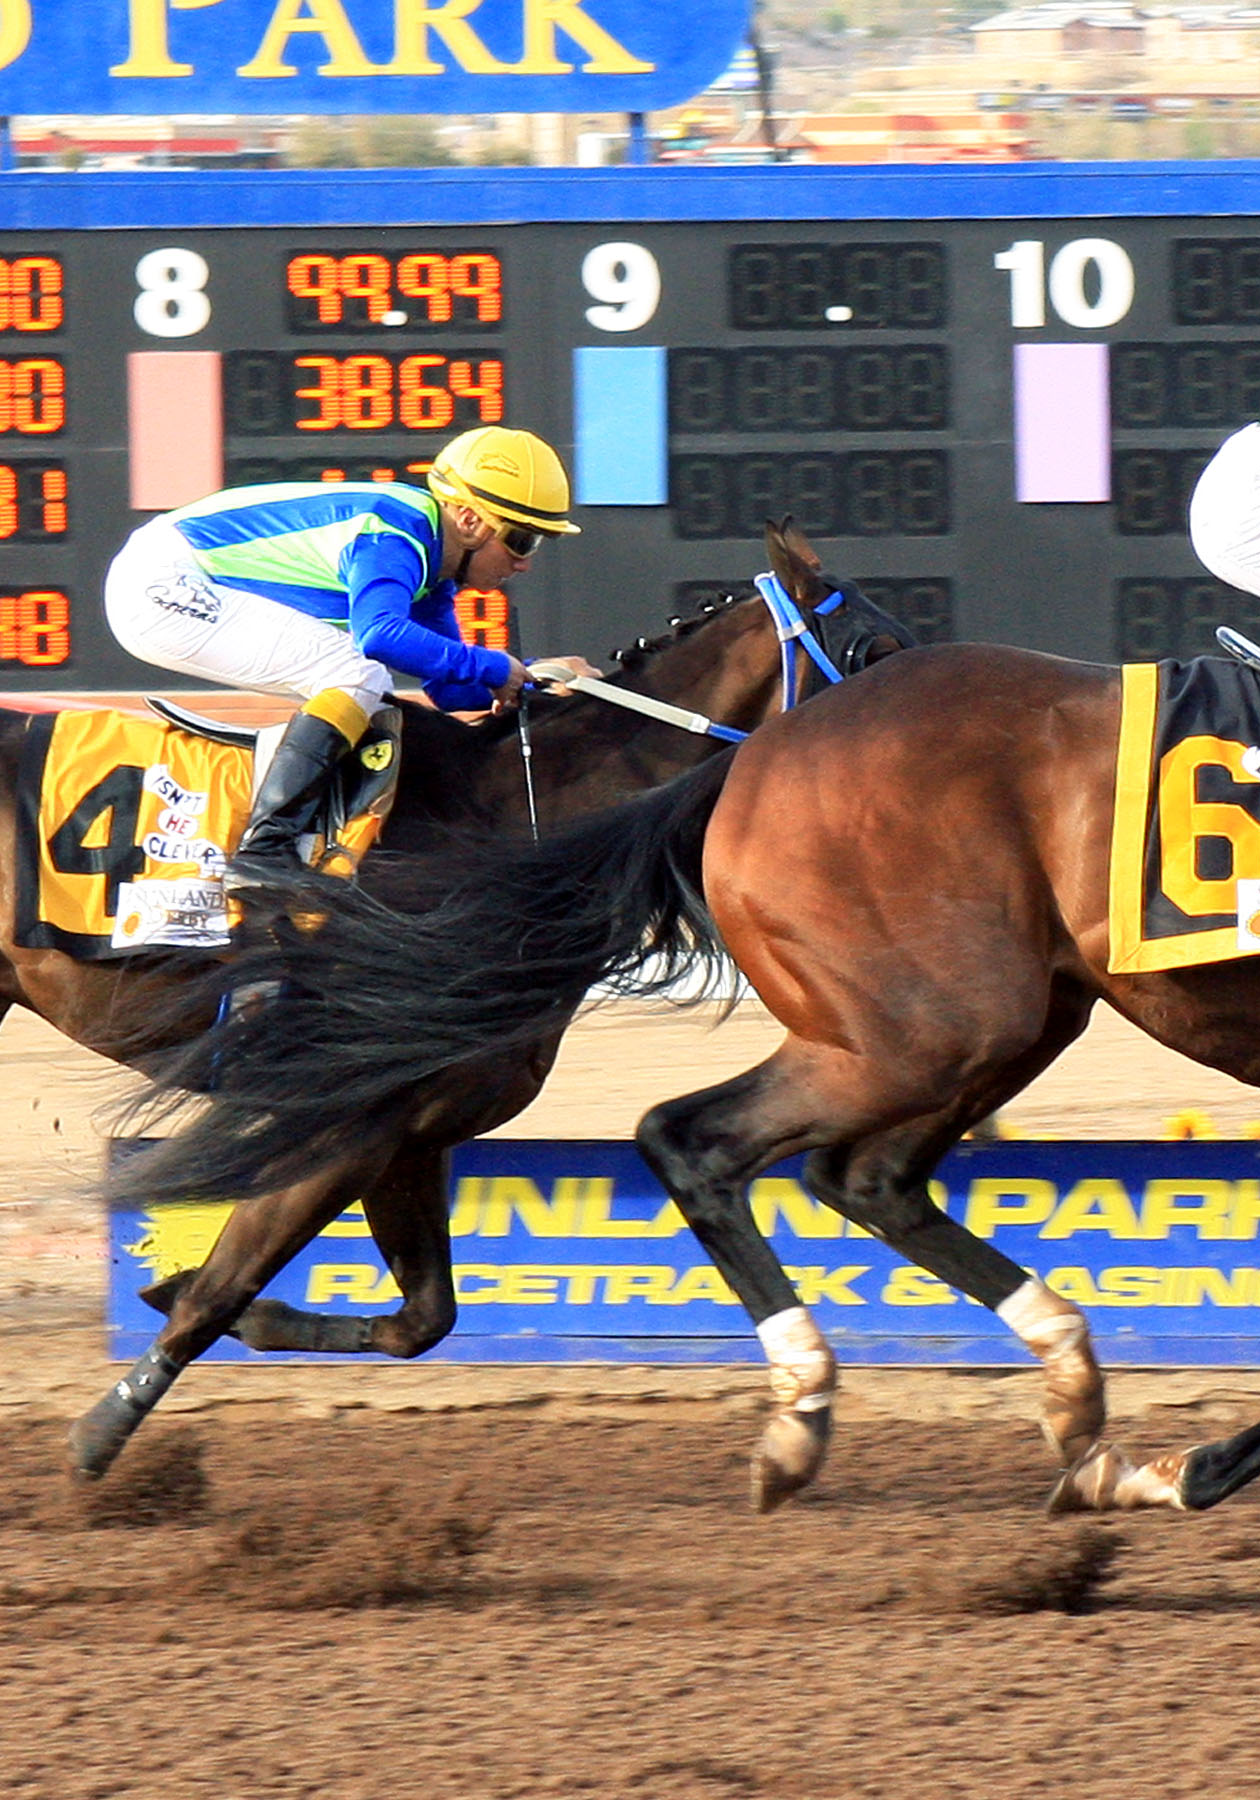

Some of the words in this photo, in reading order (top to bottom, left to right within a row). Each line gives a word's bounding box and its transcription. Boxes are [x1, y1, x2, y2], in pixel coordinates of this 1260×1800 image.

[133, 247, 212, 337] 8
[581, 242, 661, 331] 9
[994, 238, 1135, 328] 10
[294, 355, 504, 429] 3864
[47, 765, 146, 917] 4
[165, 813, 192, 835] HE
